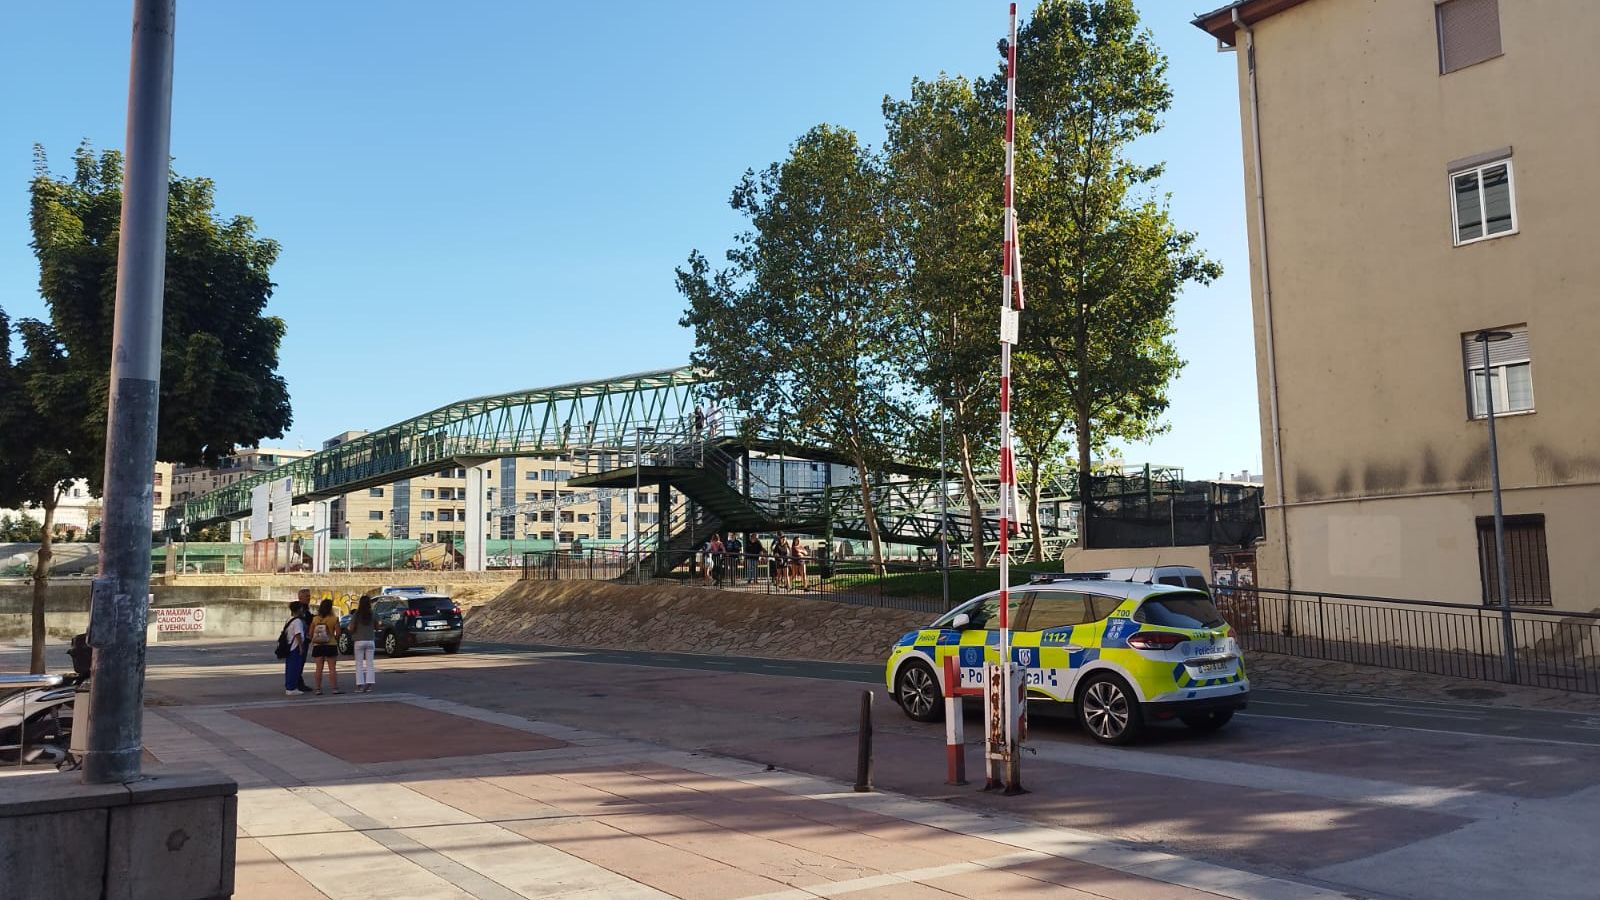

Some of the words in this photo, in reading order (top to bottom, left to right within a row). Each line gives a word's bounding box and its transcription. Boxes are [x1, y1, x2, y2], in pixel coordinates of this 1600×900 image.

[1117, 609, 1131, 617] 700
[165, 623, 203, 631] VEHICULOS
[1048, 632, 1068, 643] 112
[1026, 670, 1044, 685] cal
